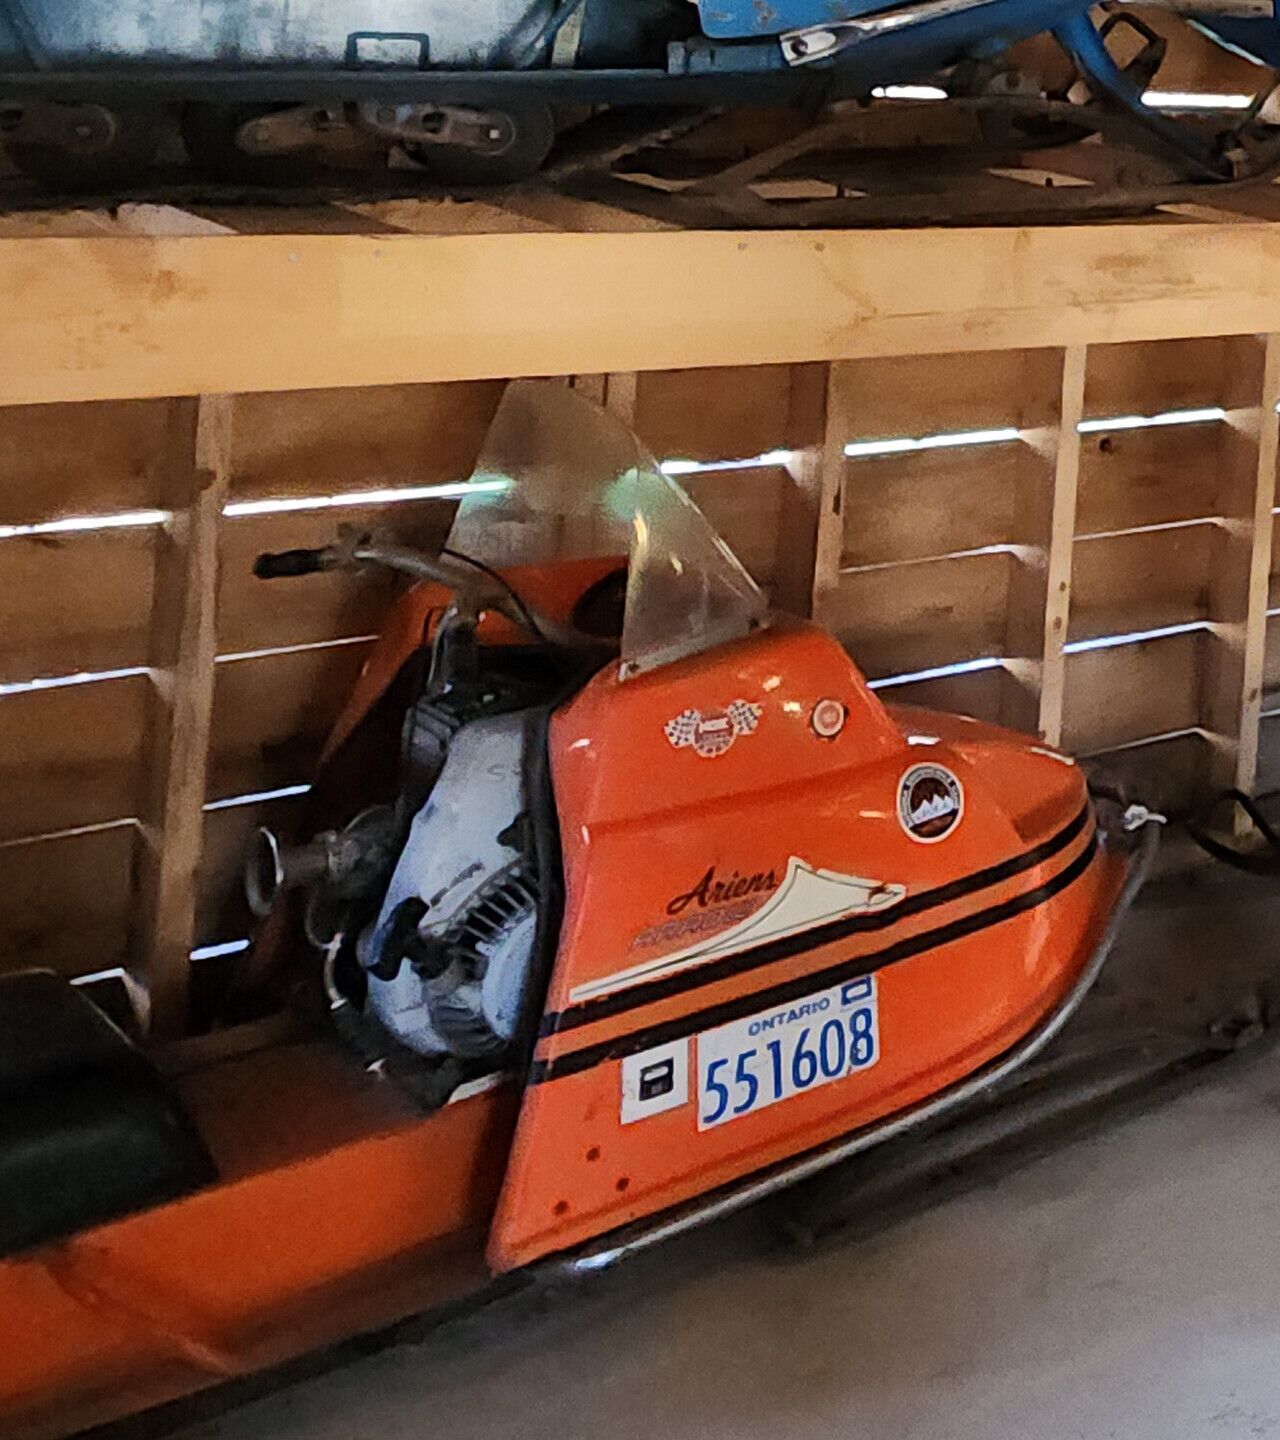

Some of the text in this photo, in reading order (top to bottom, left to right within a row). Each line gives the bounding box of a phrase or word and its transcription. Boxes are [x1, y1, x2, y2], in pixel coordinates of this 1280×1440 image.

[665, 865, 780, 916] Ariens
[747, 997, 831, 1037] ONTARIO
[702, 1007, 875, 1124] 551608
